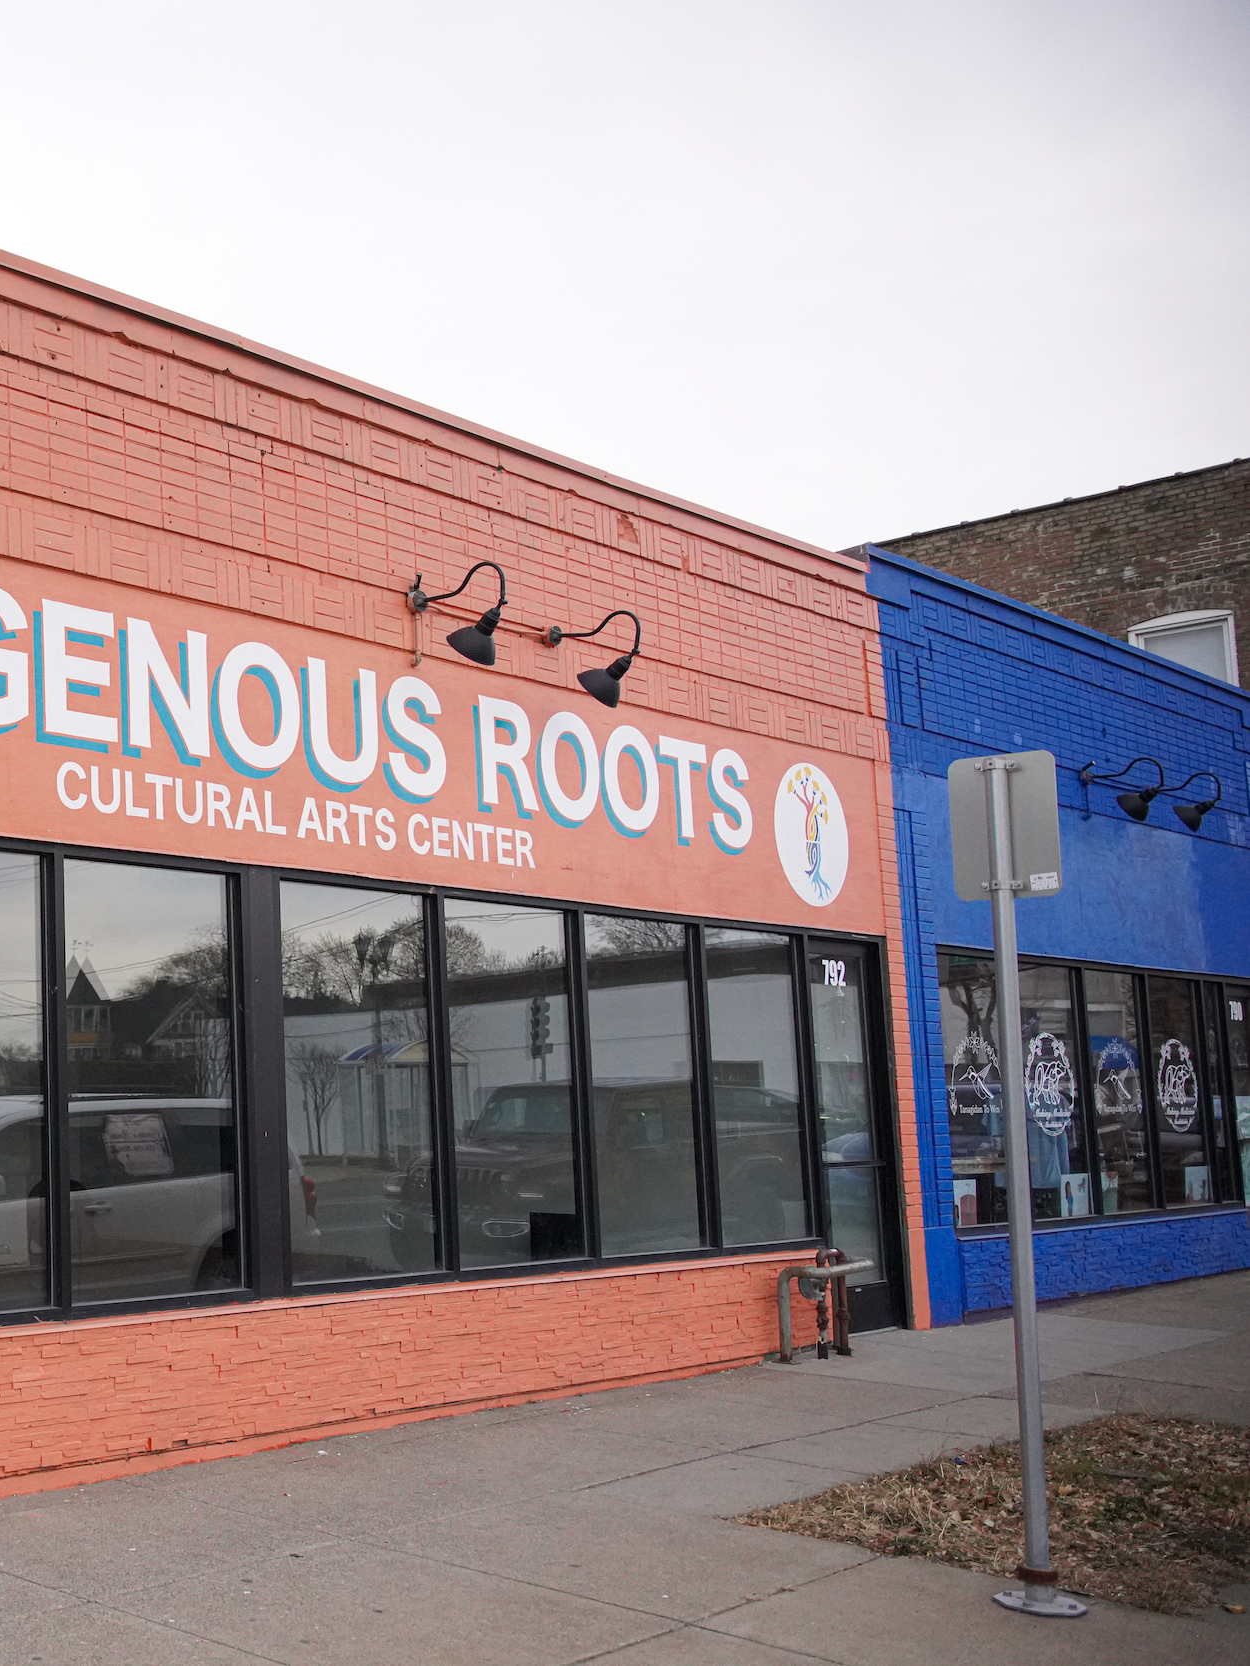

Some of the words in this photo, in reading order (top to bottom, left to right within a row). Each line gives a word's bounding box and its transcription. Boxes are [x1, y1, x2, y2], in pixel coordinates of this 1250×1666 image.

[475, 695, 753, 853] ROOTS
[56, 761, 287, 836] CULTURAL
[297, 796, 397, 852] ARTS
[407, 813, 537, 869] CENTER
[821, 959, 847, 987] 792
[1228, 1000, 1243, 1021] 790
[983, 1104, 990, 1114] To
